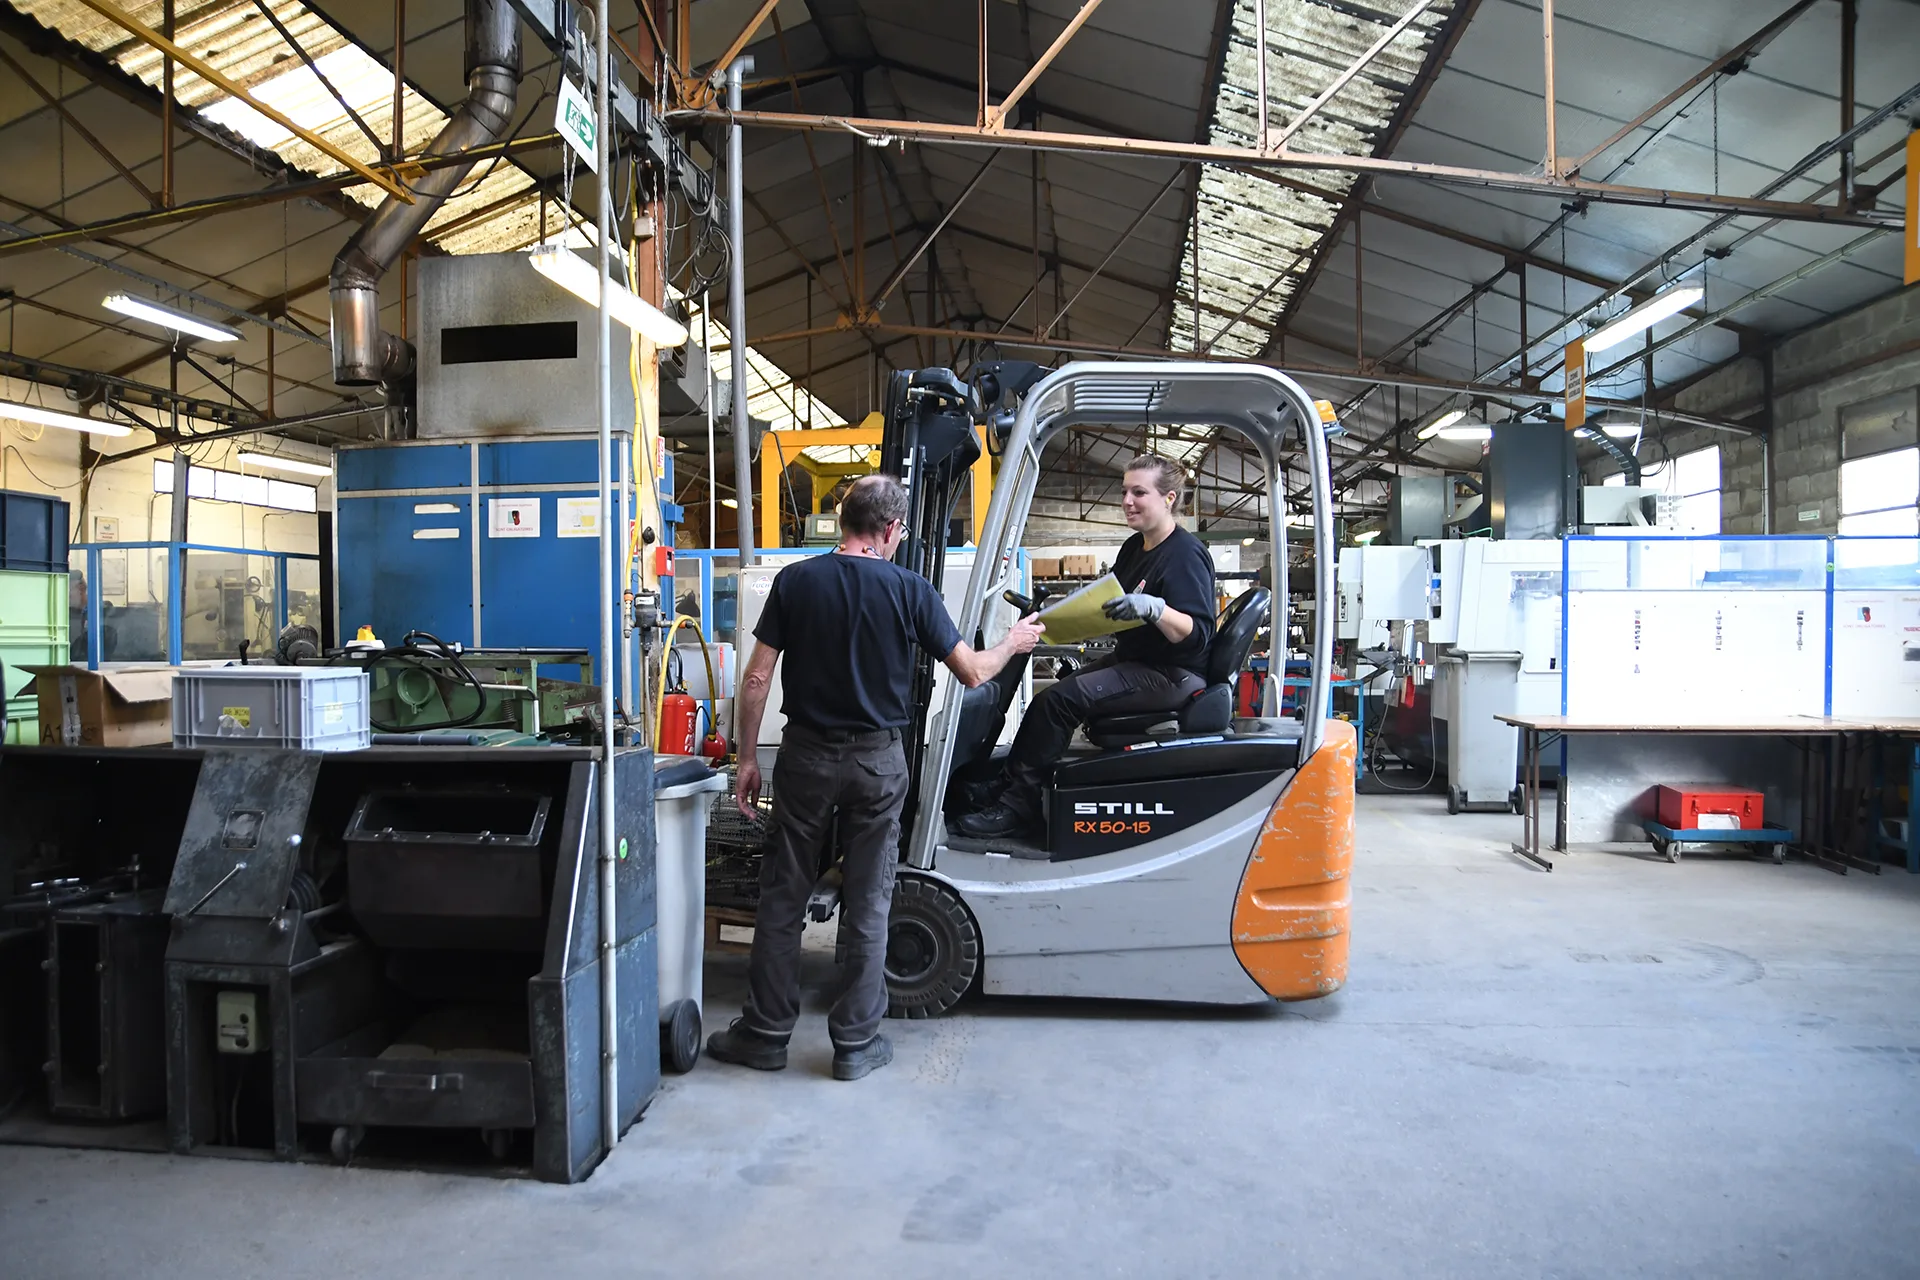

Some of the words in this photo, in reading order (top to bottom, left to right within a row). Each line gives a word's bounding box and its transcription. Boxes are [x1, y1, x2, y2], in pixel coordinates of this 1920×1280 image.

[1074, 802, 1175, 815] STILL
[1073, 821, 1097, 834] RX
[1099, 821, 1151, 834] 50-15
